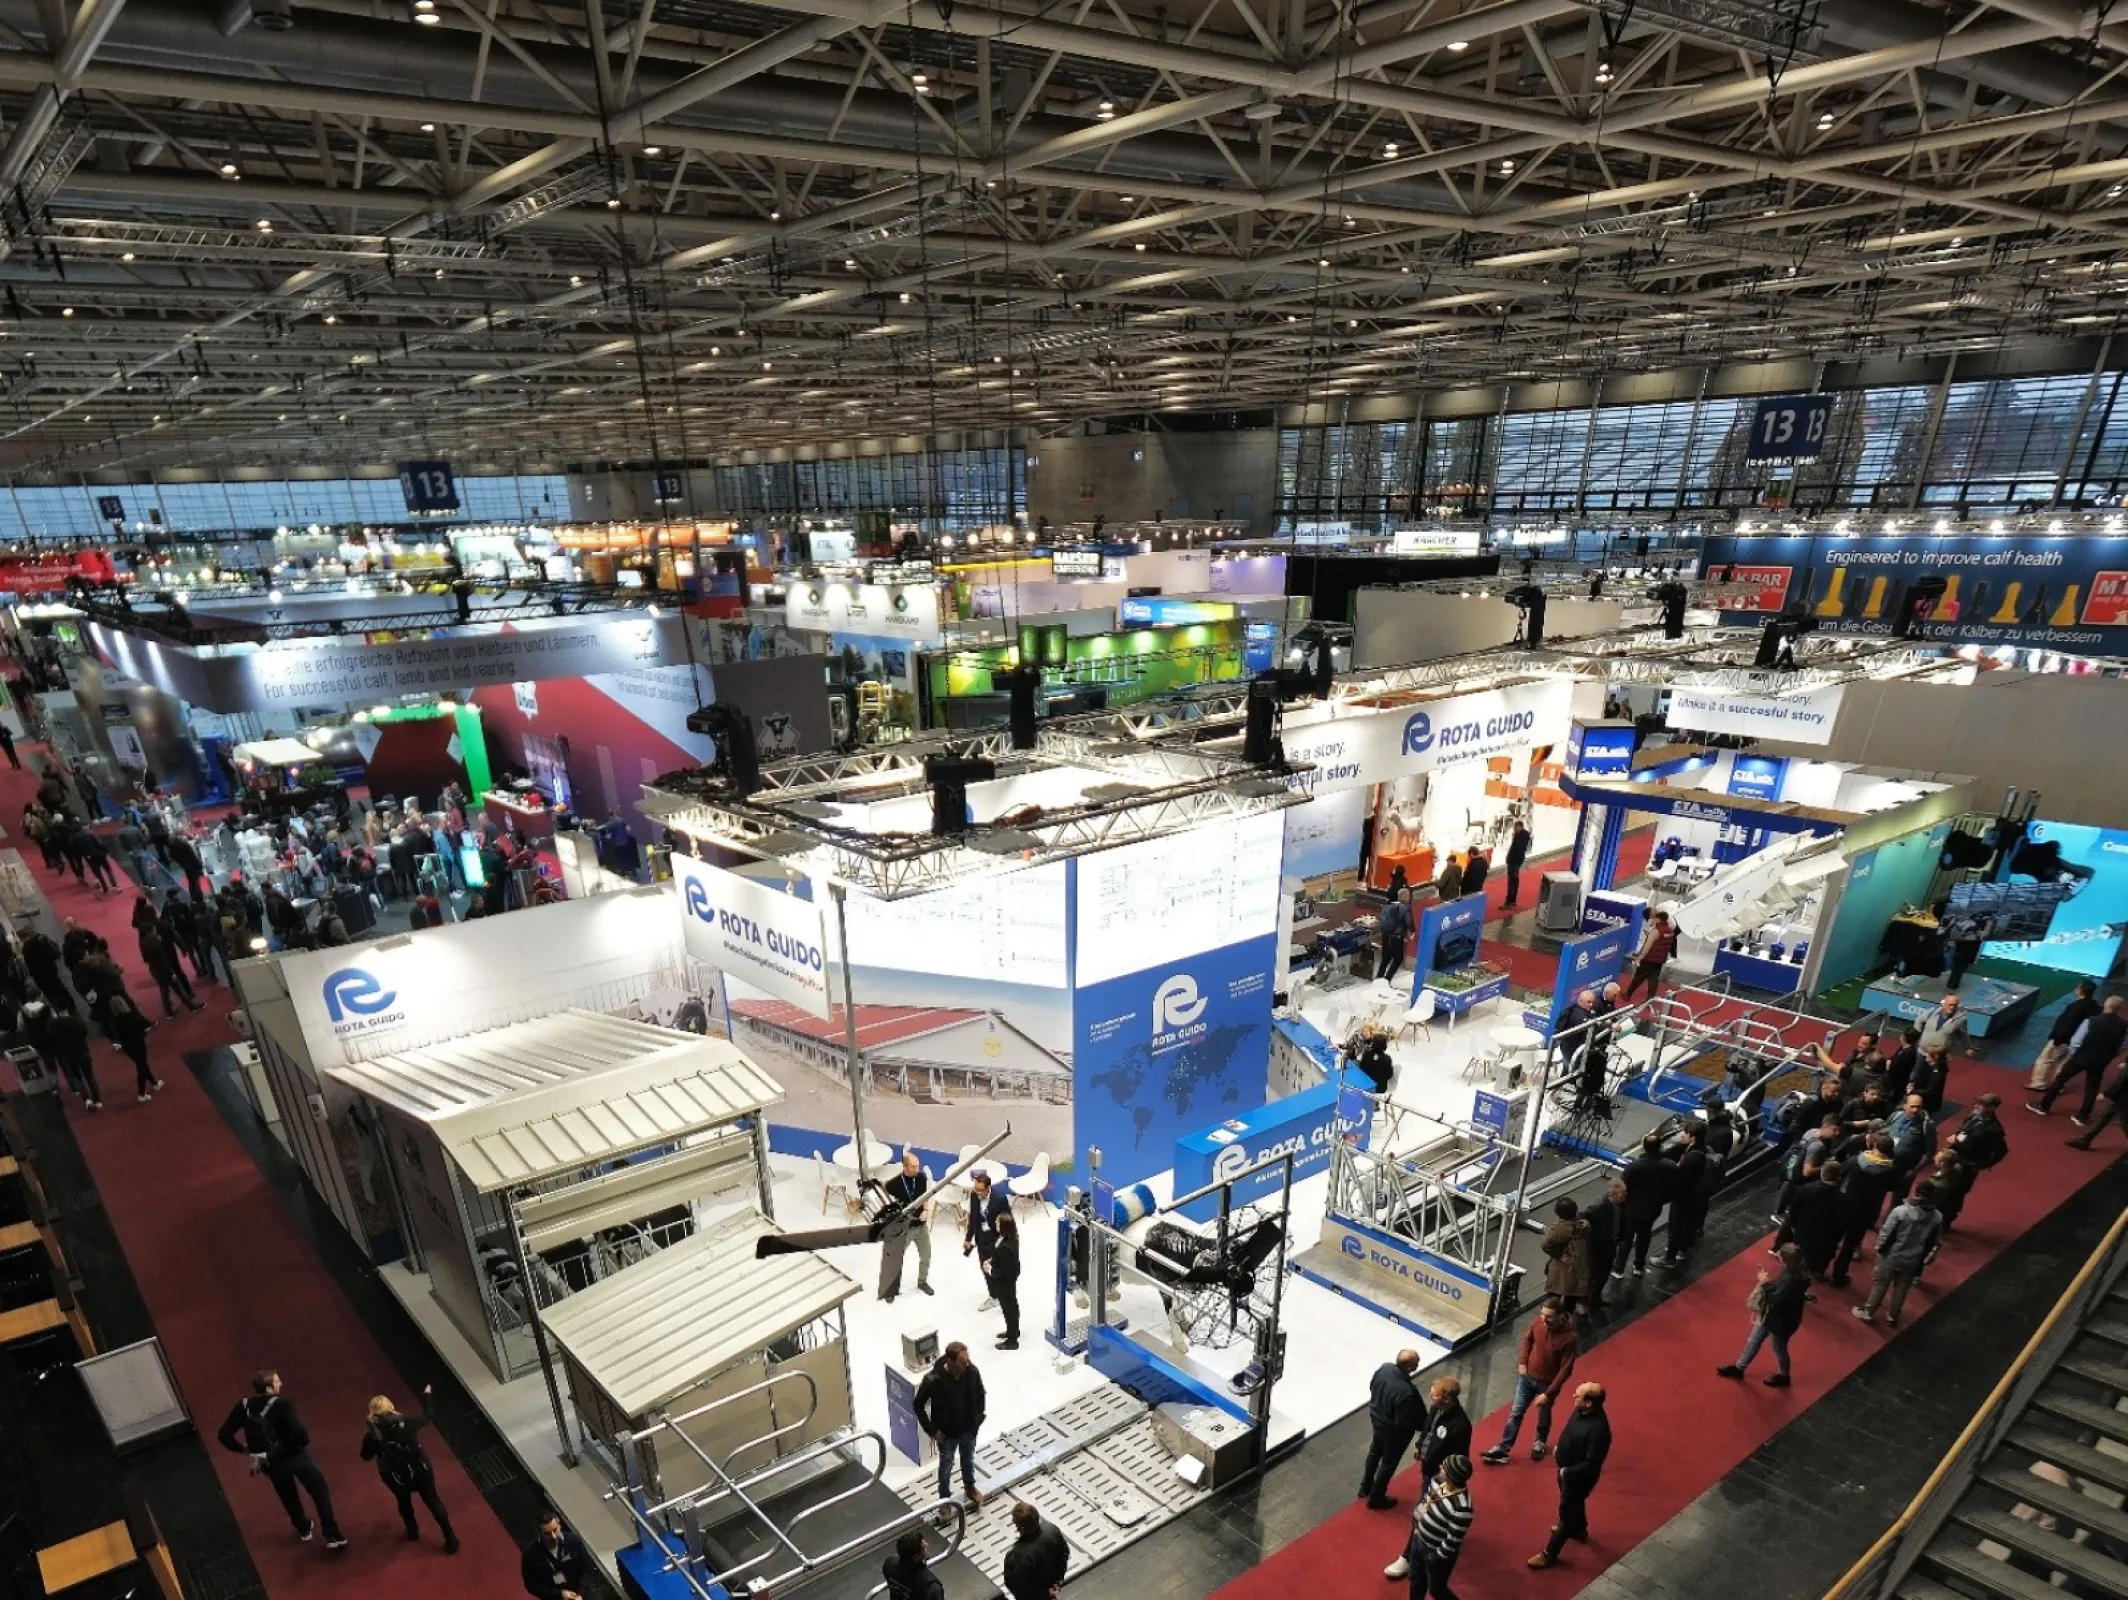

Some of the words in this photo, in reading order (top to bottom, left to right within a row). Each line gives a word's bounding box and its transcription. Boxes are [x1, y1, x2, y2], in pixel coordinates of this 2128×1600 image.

[1763, 409, 1796, 443] 13
[1805, 408, 1826, 442] 13
[419, 470, 449, 498] 13
[664, 478, 679, 493] 13
[1825, 549, 1902, 567] Engineered
[1904, 551, 1920, 565] to
[1921, 550, 1981, 568] improve
[1983, 550, 2015, 566] calf
[2013, 550, 2064, 566] health
[1750, 572, 1782, 586] BAR
[1818, 620, 1838, 631] um
[1840, 618, 1859, 632] die
[1934, 622, 1956, 636] der
[2004, 626, 2022, 640] zu
[2025, 627, 2104, 644] verbessern
[316, 651, 393, 673] erfolgreiche
[395, 646, 451, 664] Aufzucht
[453, 645, 475, 659] von
[524, 636, 545, 652] und
[263, 682, 287, 699] For
[290, 674, 362, 697] successful
[364, 670, 393, 689] calf,
[394, 667, 425, 685] lamb
[428, 666, 450, 681] and
[1678, 697, 1707, 709] Make
[1708, 698, 1717, 711] it
[1718, 703, 1725, 712] a
[1728, 705, 1788, 719] succesful
[1791, 711, 1827, 724] story.
[1439, 721, 1481, 748] ROTA
[1486, 711, 1534, 738] GUIDO
[1289, 747, 1299, 761] is
[1303, 749, 1311, 760] a
[1326, 762, 1363, 781] story.
[719, 908, 763, 946] ROTA
[766, 927, 823, 972] GUIDO
[335, 1022, 366, 1034] ROTA
[368, 1012, 405, 1027] GUIDO
[1152, 1032, 1176, 1048] ROTA
[1178, 1022, 1207, 1039] GUIDO
[1257, 1133, 1307, 1165] ROTA
[1370, 1250, 1409, 1278] ROTA
[1413, 1269, 1463, 1301] GUIDO
